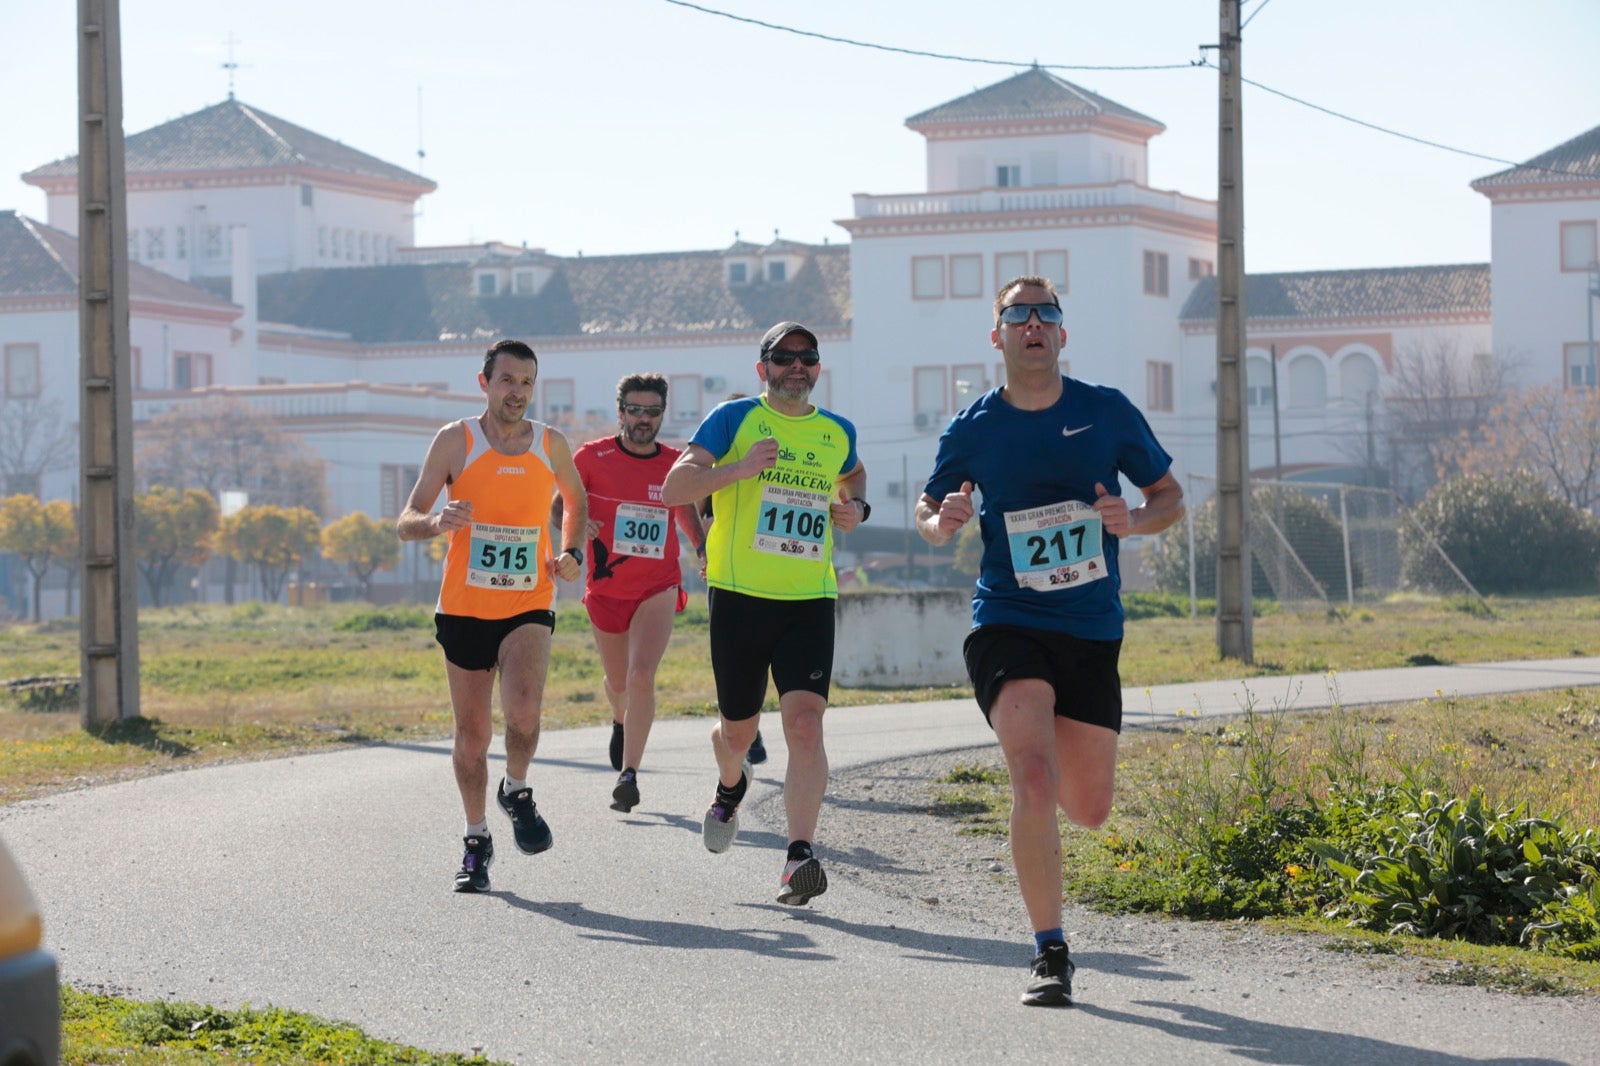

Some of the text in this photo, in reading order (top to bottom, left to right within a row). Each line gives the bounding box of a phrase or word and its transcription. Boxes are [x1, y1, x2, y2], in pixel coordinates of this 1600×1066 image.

[758, 470, 832, 493] MARACENA
[782, 488, 795, 497] GRAN
[795, 490, 811, 499] PREMIO
[811, 492, 817, 500] DE
[764, 506, 826, 539] 1106
[1027, 511, 1045, 520] GRAN
[1045, 505, 1067, 517] PREMIO
[1068, 503, 1075, 512] DE
[489, 525, 502, 534] GRAN
[502, 526, 520, 535] PREMIO
[520, 528, 525, 536] DE
[624, 520, 660, 542] 300
[1027, 525, 1086, 566] 217
[480, 544, 528, 571] 515
